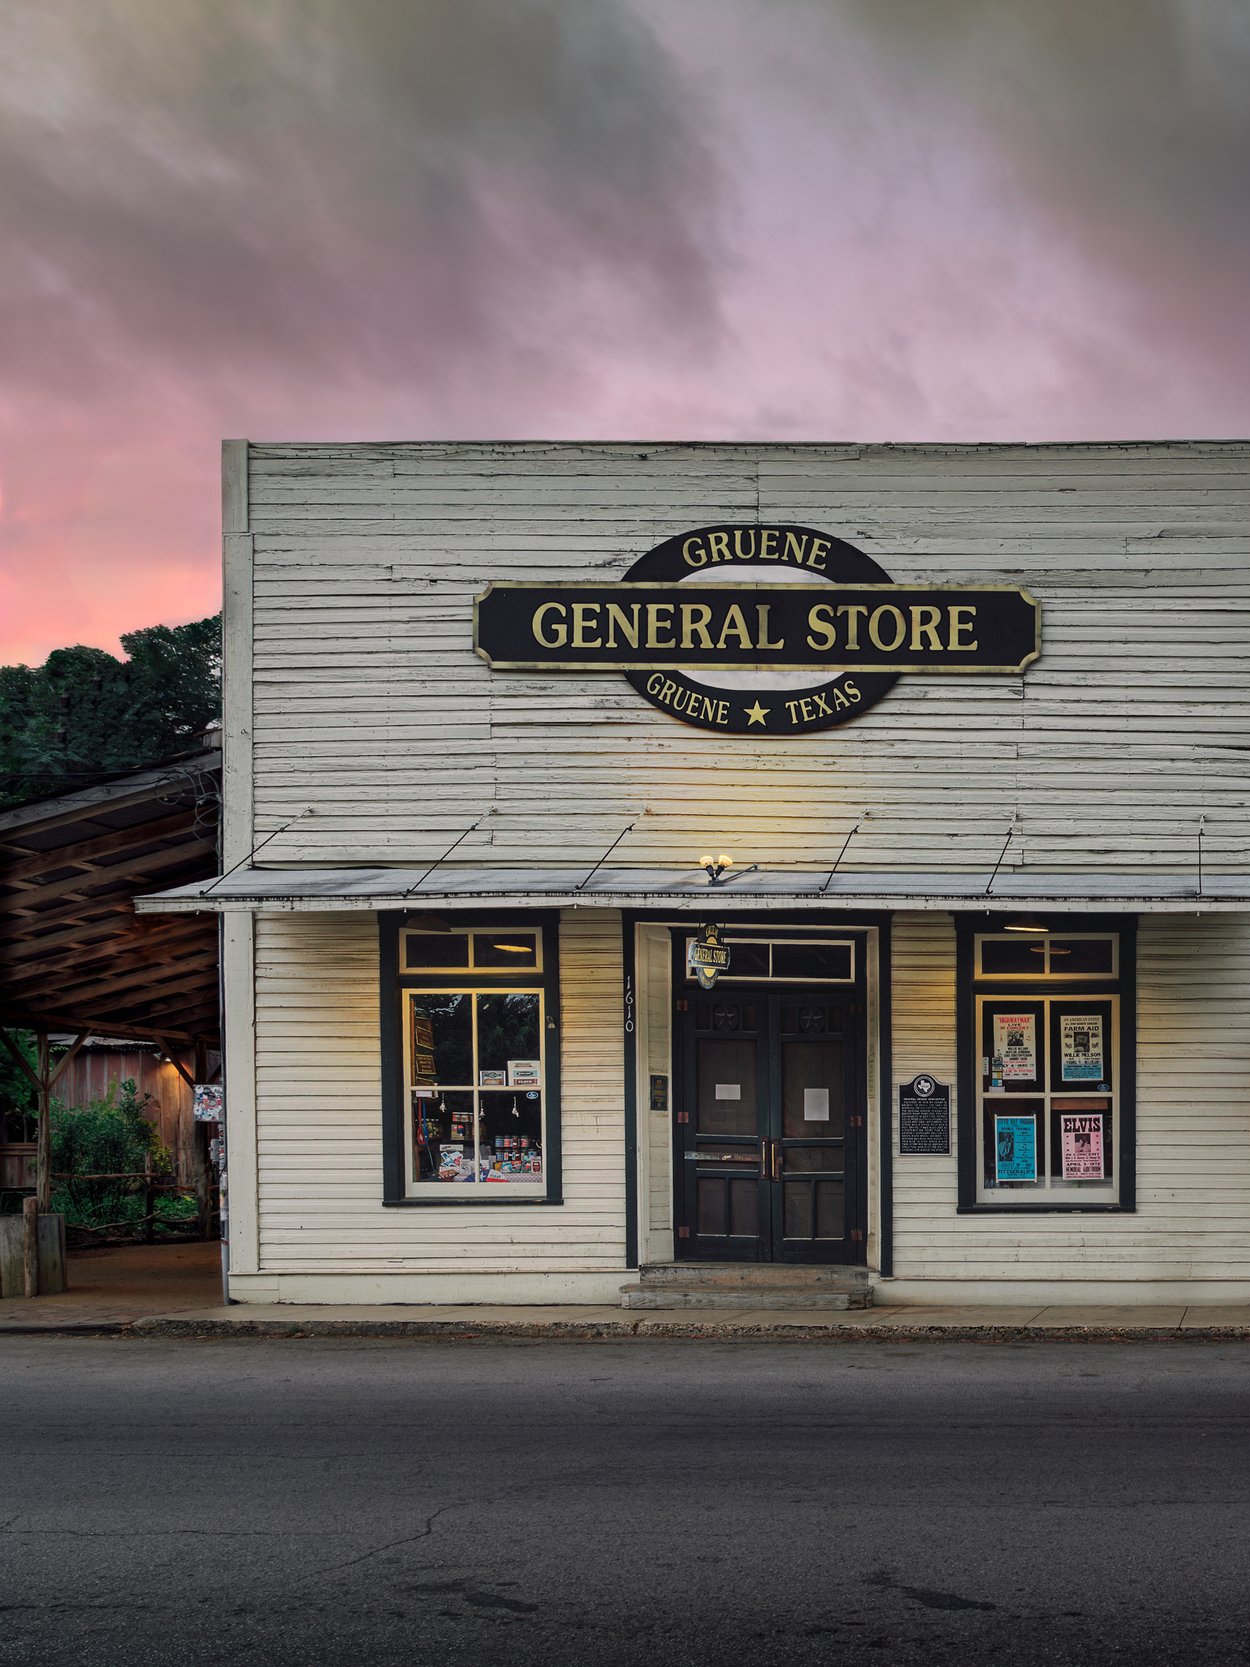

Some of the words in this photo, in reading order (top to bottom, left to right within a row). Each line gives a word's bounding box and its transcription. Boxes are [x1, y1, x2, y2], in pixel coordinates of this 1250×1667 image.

[681, 529, 833, 572] GRUENE
[531, 601, 785, 652] GENERAL
[805, 603, 979, 652] STORE
[645, 672, 731, 725] GRUENE
[784, 680, 863, 725] TEXAS
[625, 975, 634, 1032] 1610
[1064, 1117, 1101, 1133] ELVIS
